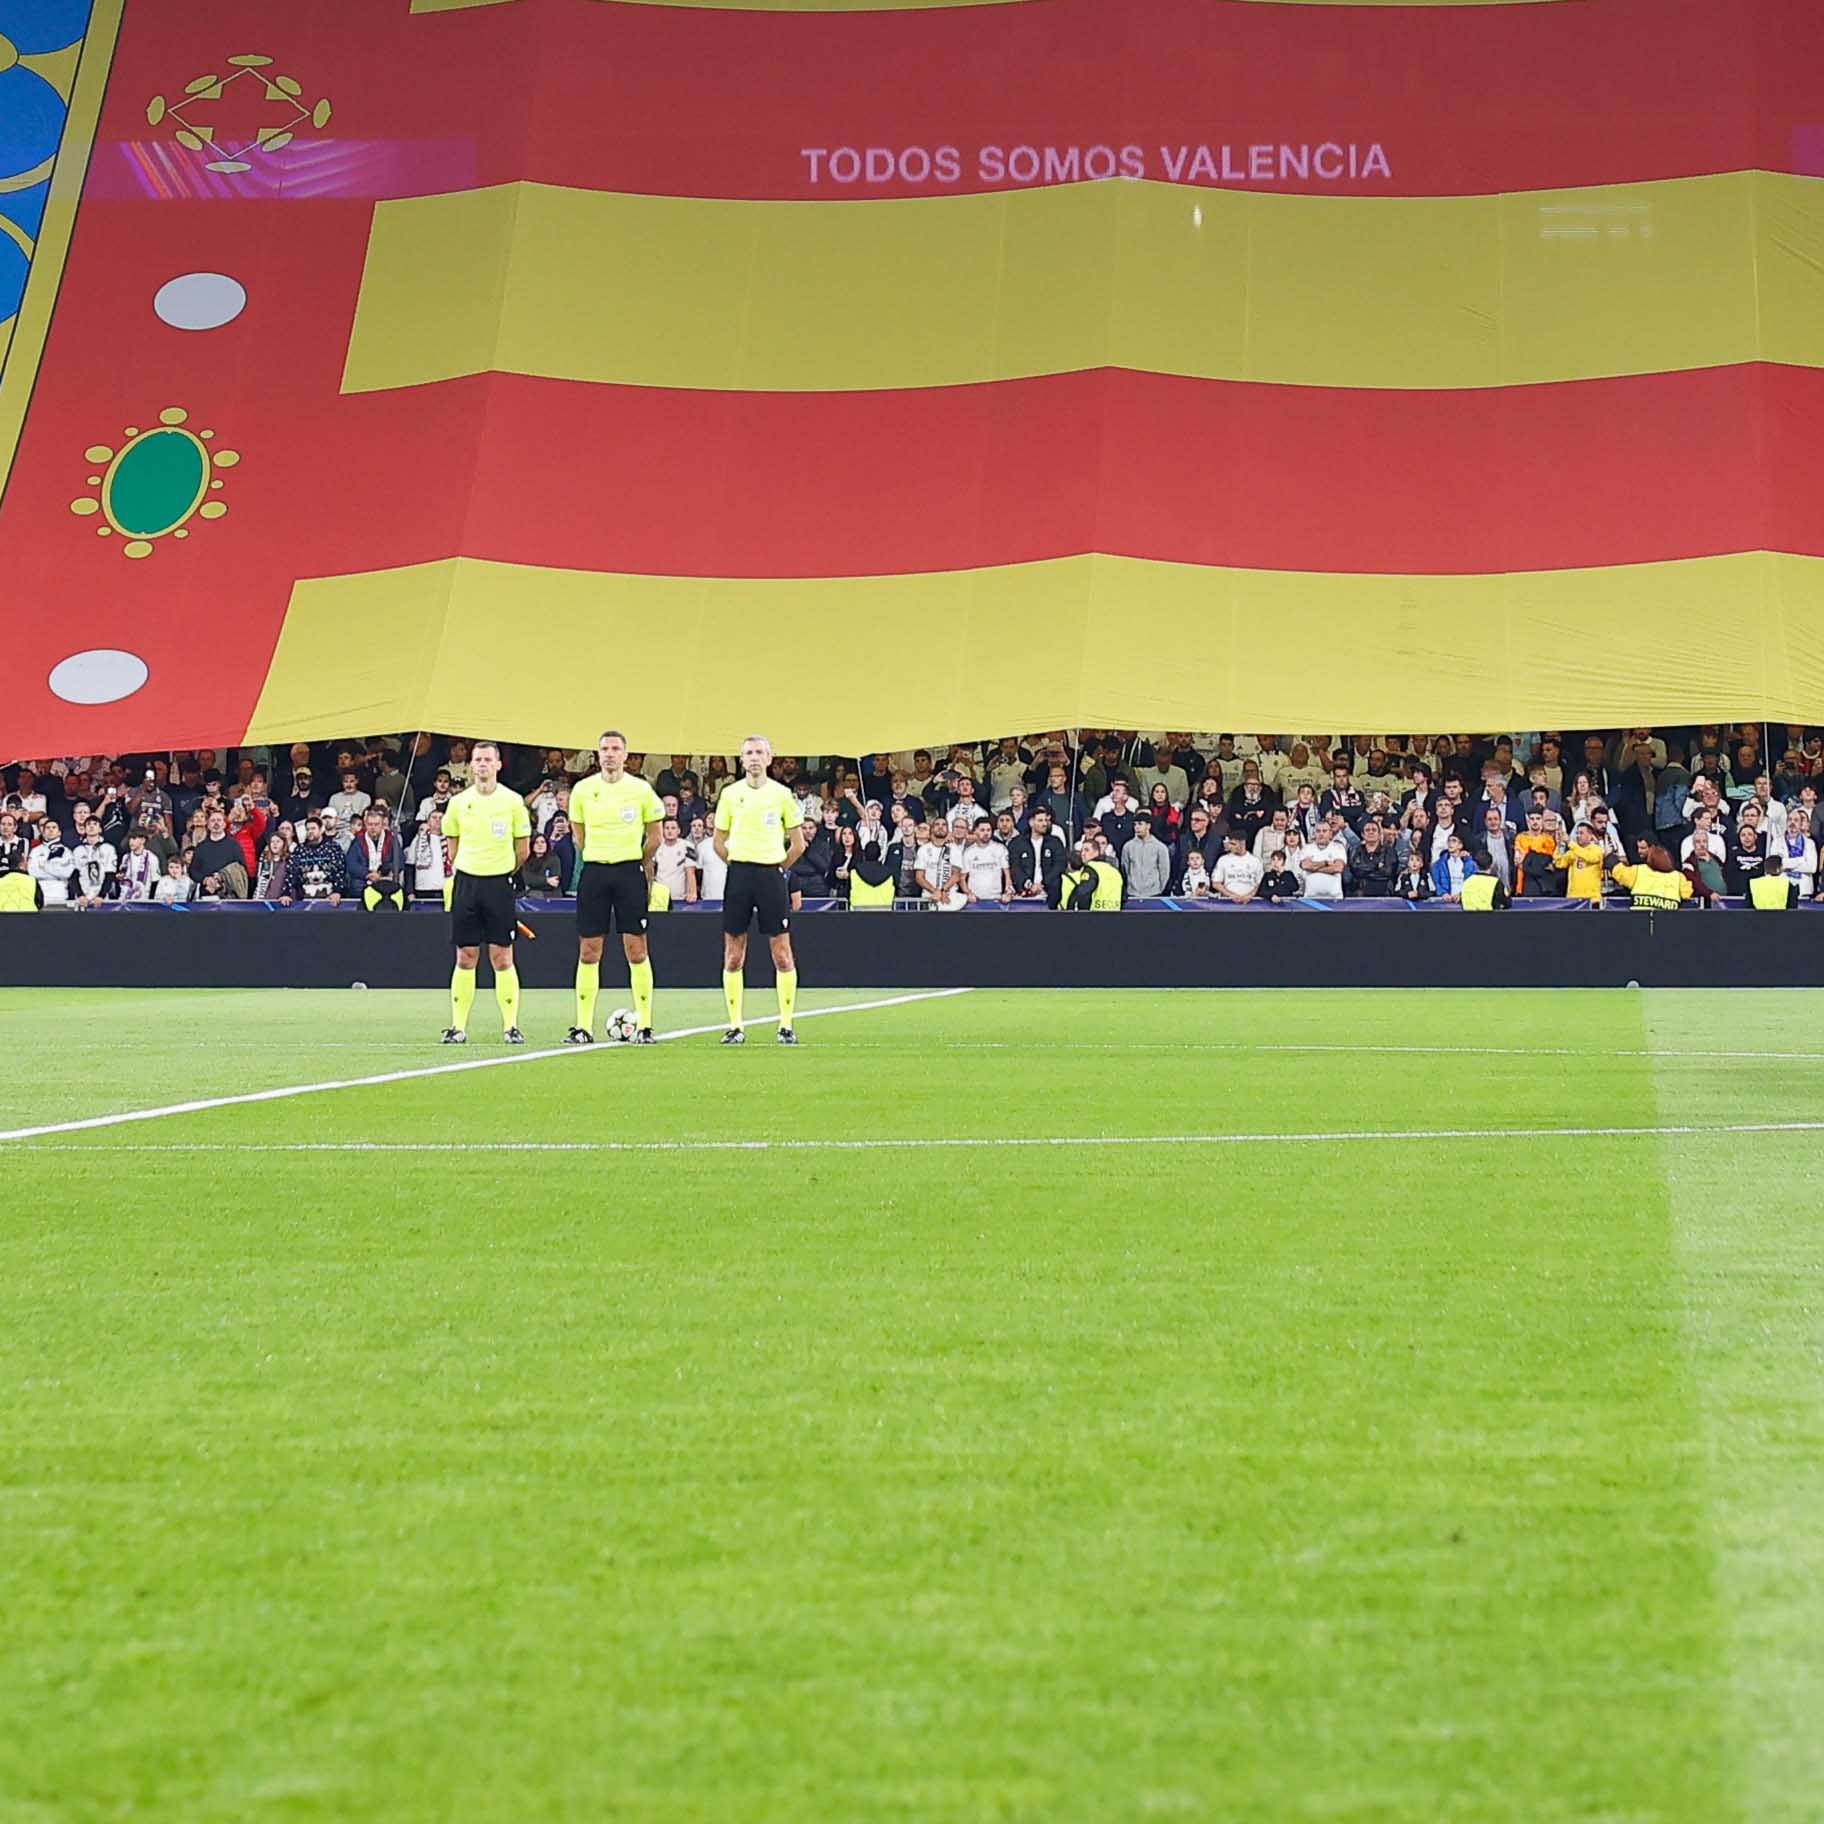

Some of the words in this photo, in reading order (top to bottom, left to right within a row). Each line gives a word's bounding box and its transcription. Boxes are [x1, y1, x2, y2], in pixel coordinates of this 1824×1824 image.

[801, 146, 961, 184] TODOS
[977, 144, 1146, 183] SOMOS
[1160, 142, 1393, 180] VALENCIA
[1633, 895, 1679, 911] STEWARD
